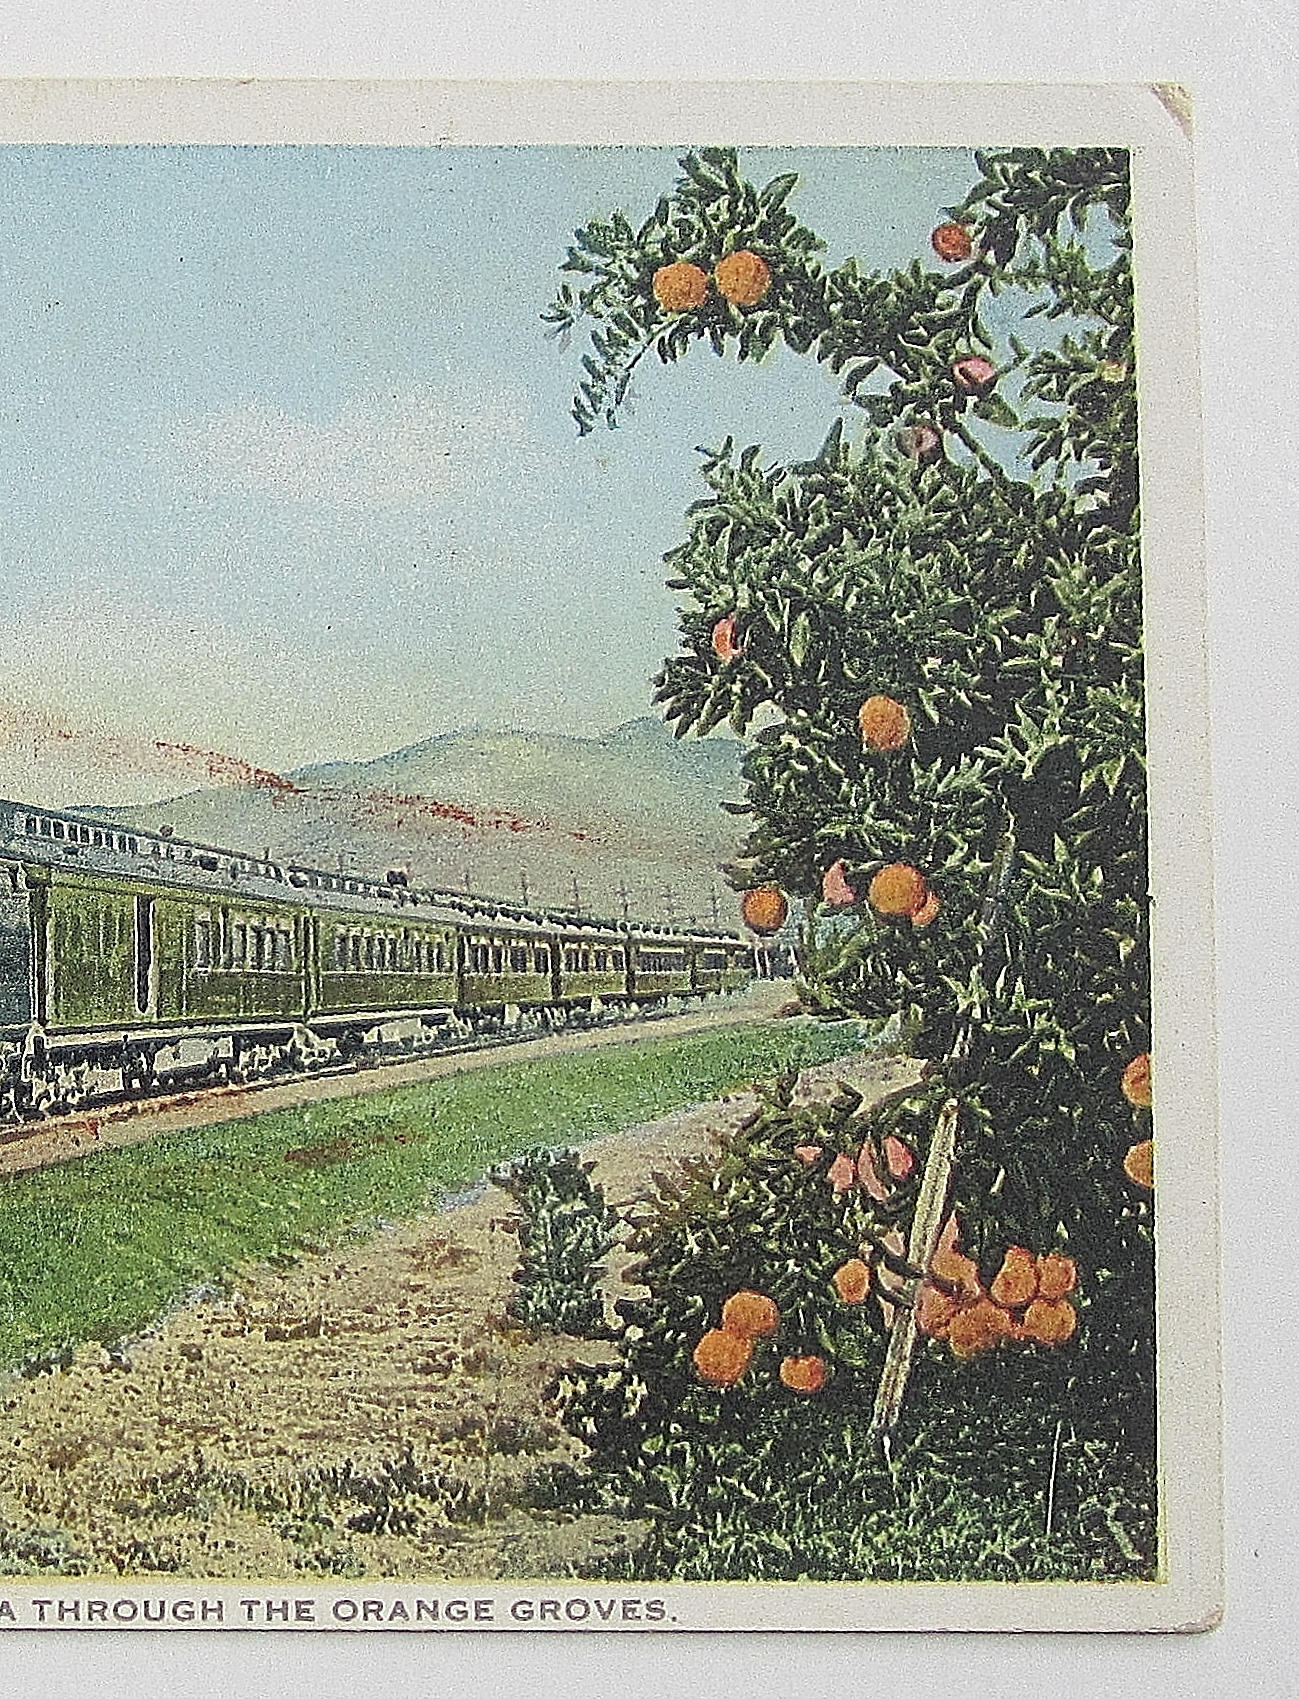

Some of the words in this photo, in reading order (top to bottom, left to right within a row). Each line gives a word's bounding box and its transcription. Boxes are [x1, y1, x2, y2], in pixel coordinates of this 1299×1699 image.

[32, 1599, 224, 1624] THROUGH
[240, 1600, 315, 1623] THE
[332, 1598, 495, 1623] ORANGE
[510, 1598, 678, 1623] GROVES.
